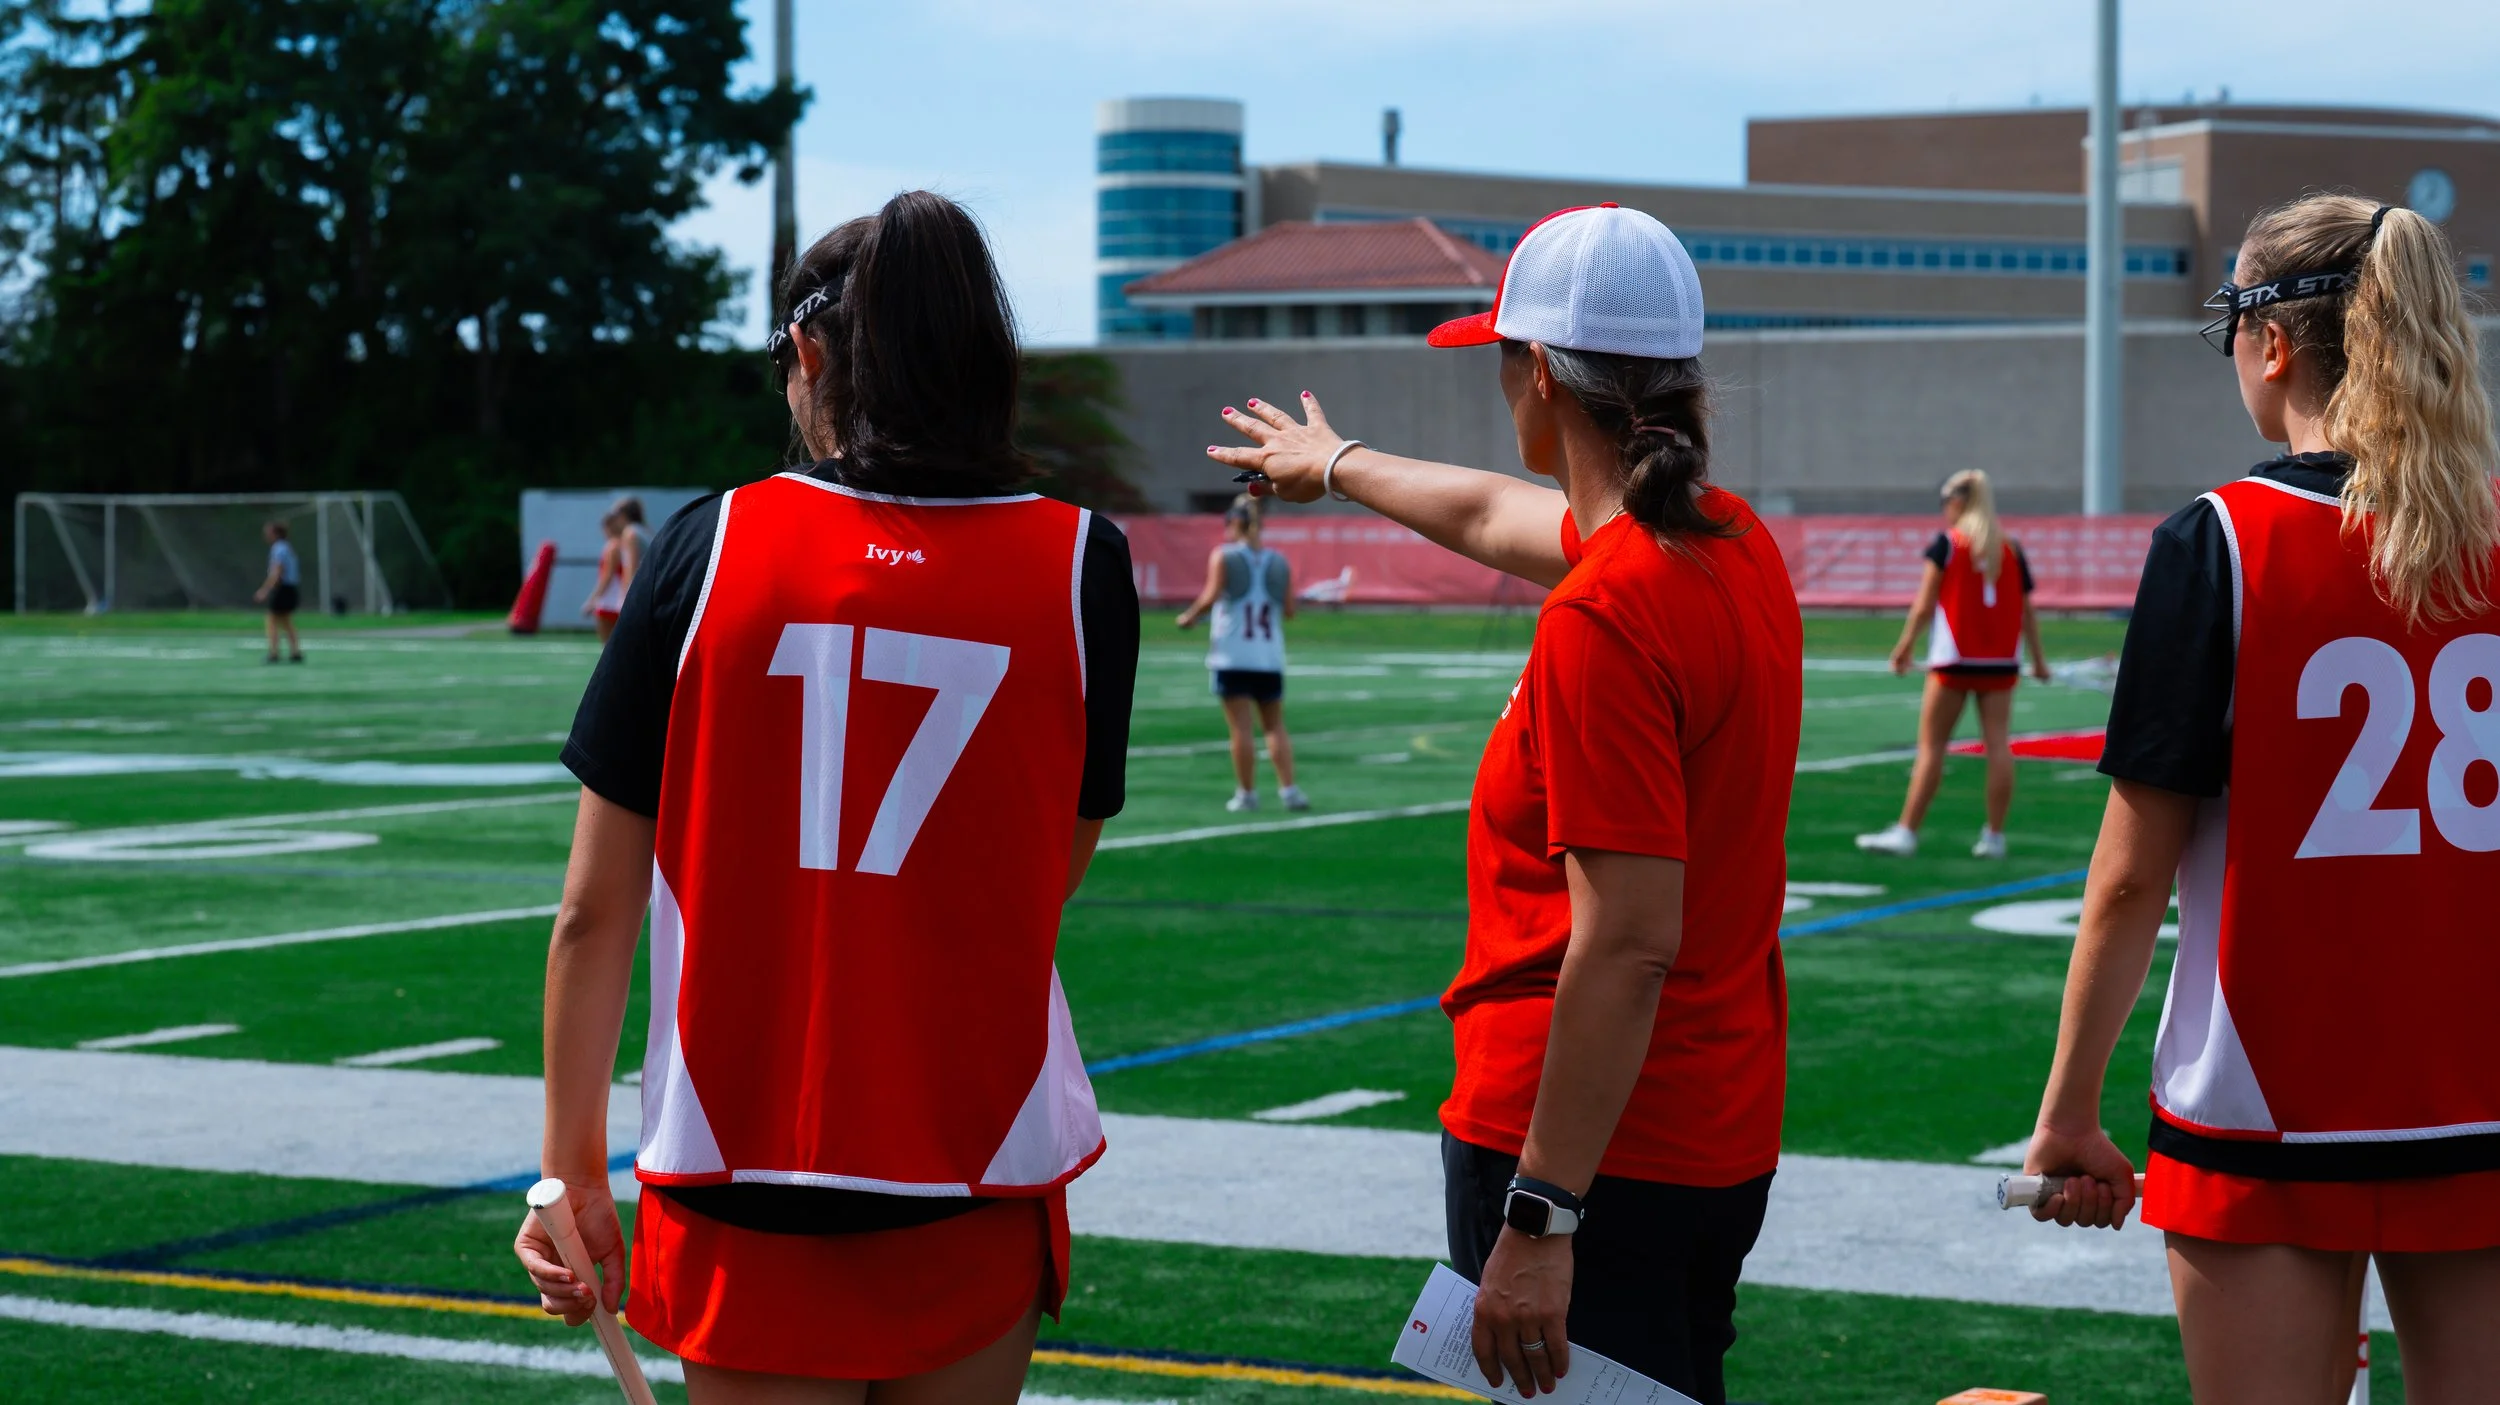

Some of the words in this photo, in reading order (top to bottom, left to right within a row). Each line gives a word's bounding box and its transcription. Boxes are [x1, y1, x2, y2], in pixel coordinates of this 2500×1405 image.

[2238, 283, 2281, 309] STX
[2297, 272, 2356, 294] STX
[794, 285, 829, 324] STX
[766, 322, 787, 352] TX
[865, 543, 905, 566] Ivy
[1244, 602, 1272, 641] 14
[767, 623, 1011, 876] 17
[2294, 633, 2500, 859] 28
[1412, 1319, 1428, 1334] C
